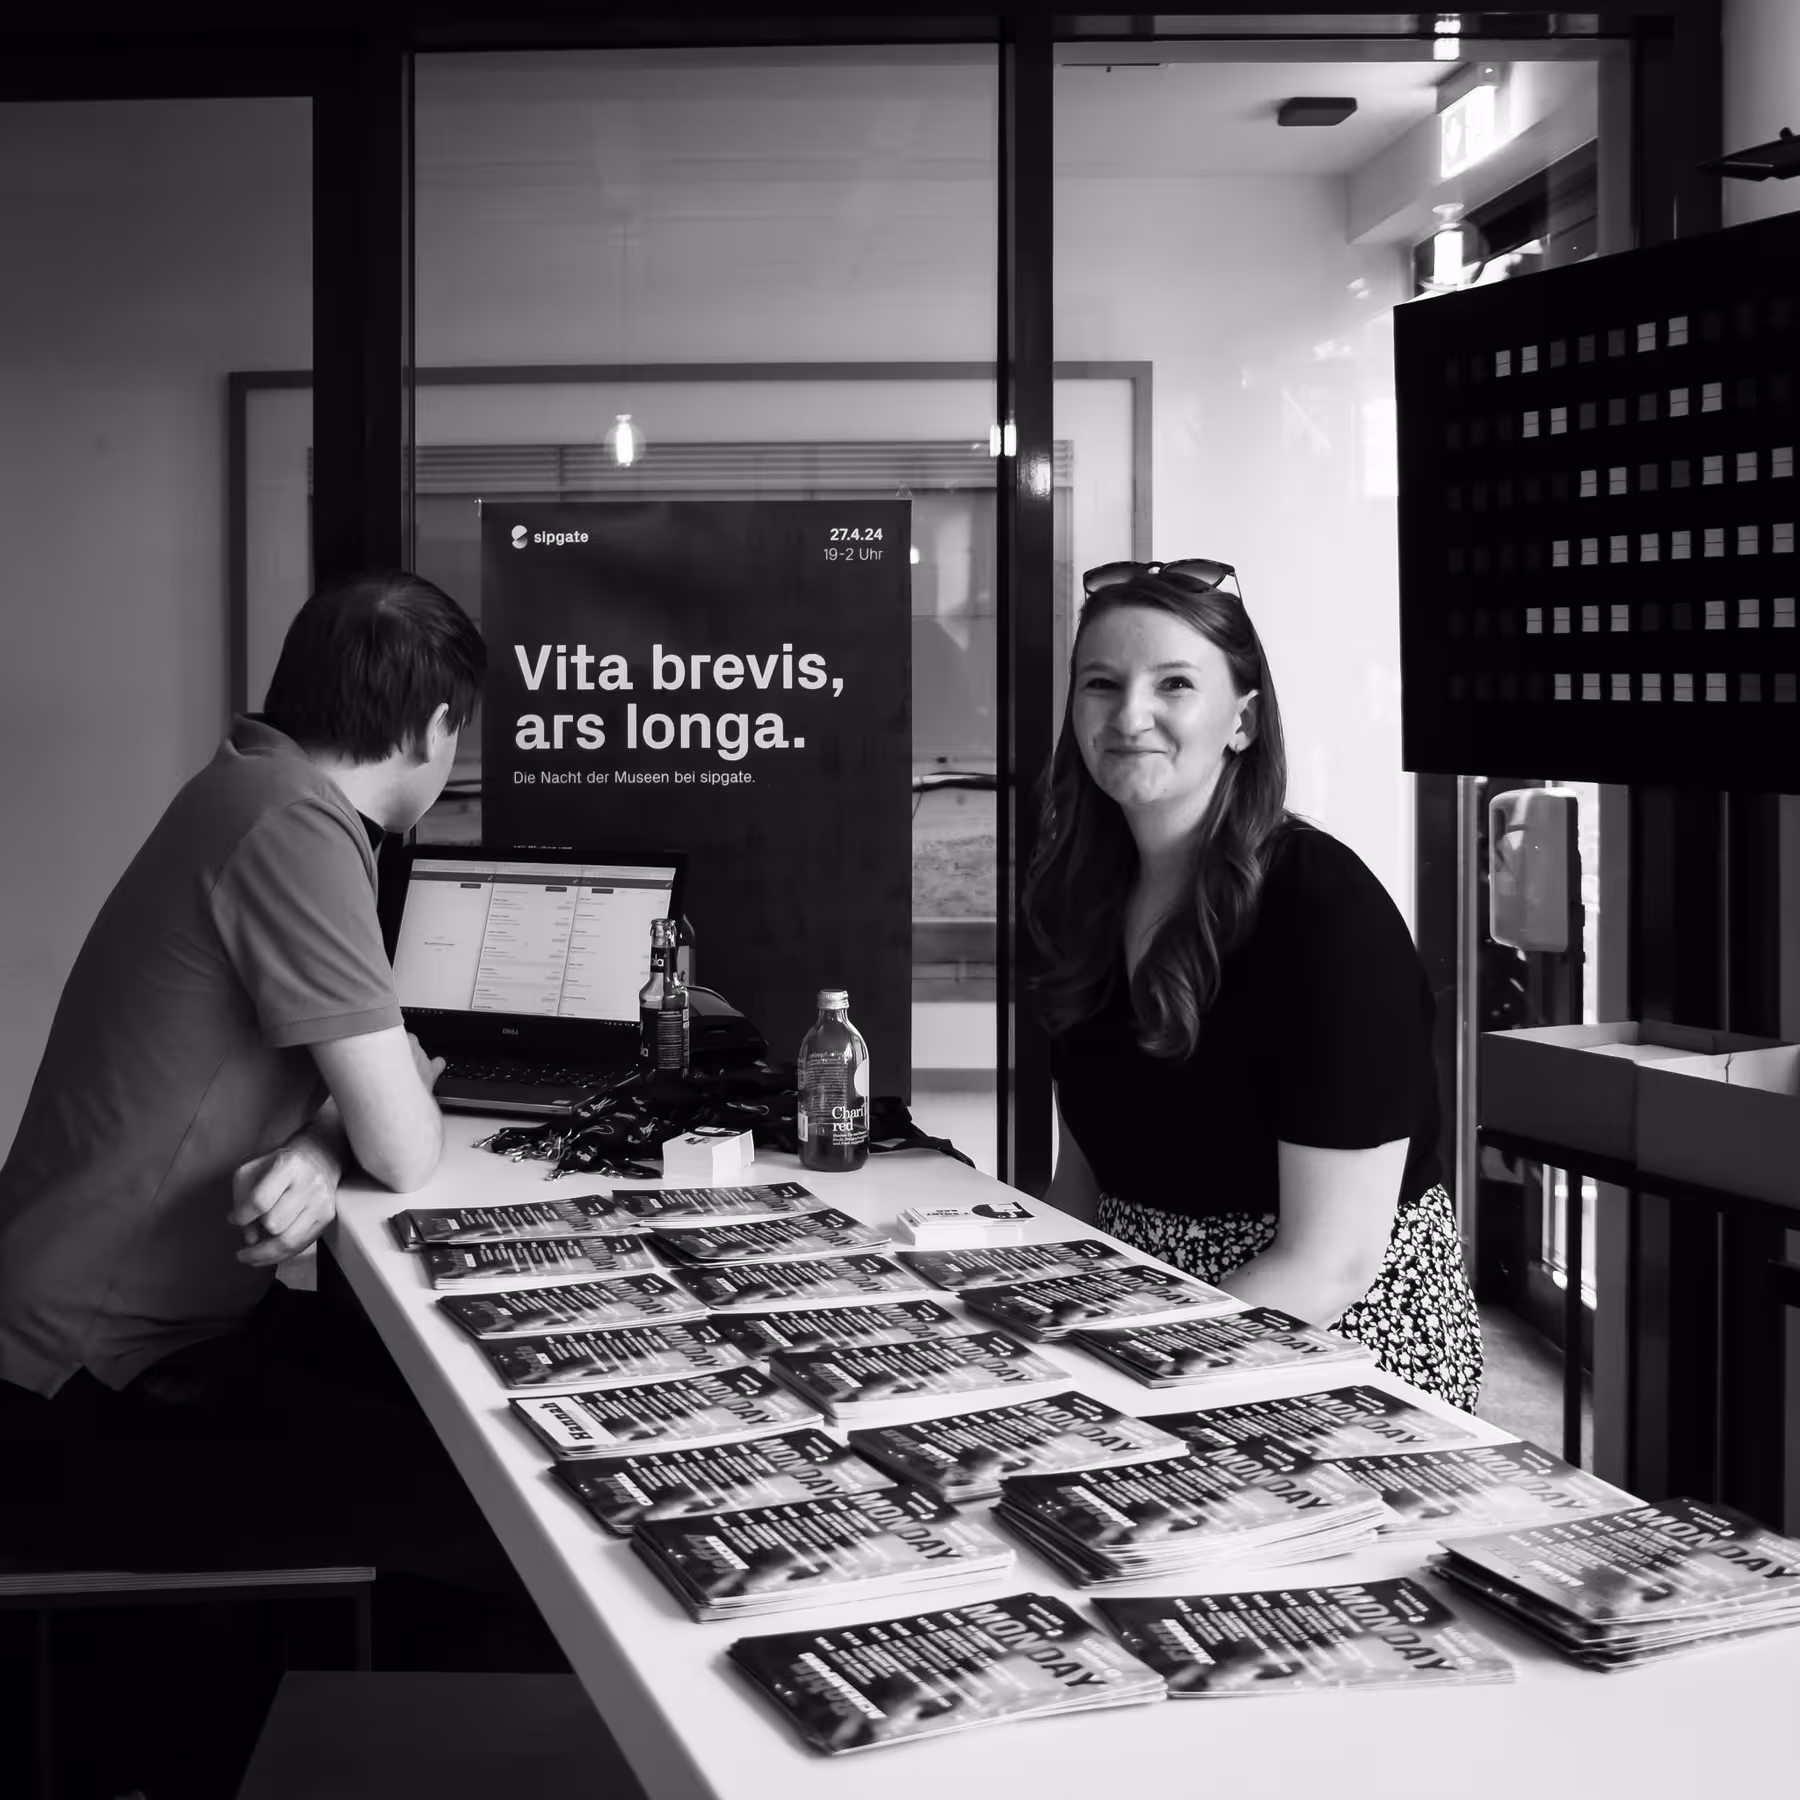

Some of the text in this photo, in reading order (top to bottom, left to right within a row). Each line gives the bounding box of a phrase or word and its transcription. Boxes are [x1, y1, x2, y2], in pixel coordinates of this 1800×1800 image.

[533, 530, 589, 546] sipgate
[823, 547, 884, 561] 19-2 Uhr
[830, 528, 884, 541] 27.4.24
[514, 643, 844, 698] Vita brevis,
[515, 703, 805, 761] ars longa.
[513, 770, 755, 786] Die Nacht der Museen bei sipgate.
[832, 1117, 854, 1131] red
[1041, 1243, 1103, 1272] MONDA
[873, 1303, 939, 1339] MONDA
[1216, 1313, 1329, 1354] MONDAY
[539, 1401, 594, 1441] Hannah
[688, 1375, 777, 1424] MONDAY
[1302, 1393, 1425, 1444] MONDAY
[1020, 1400, 1140, 1452] MONDAY
[752, 1438, 848, 1498] MONDAY
[1206, 1447, 1333, 1510] MONDAY
[1463, 1447, 1587, 1510] MONDAY
[848, 1491, 963, 1559] MONDAY
[1626, 1507, 1800, 1579] MONDAY
[959, 1602, 1108, 1688] MONDAY
[1327, 1585, 1458, 1670] MONDAY
